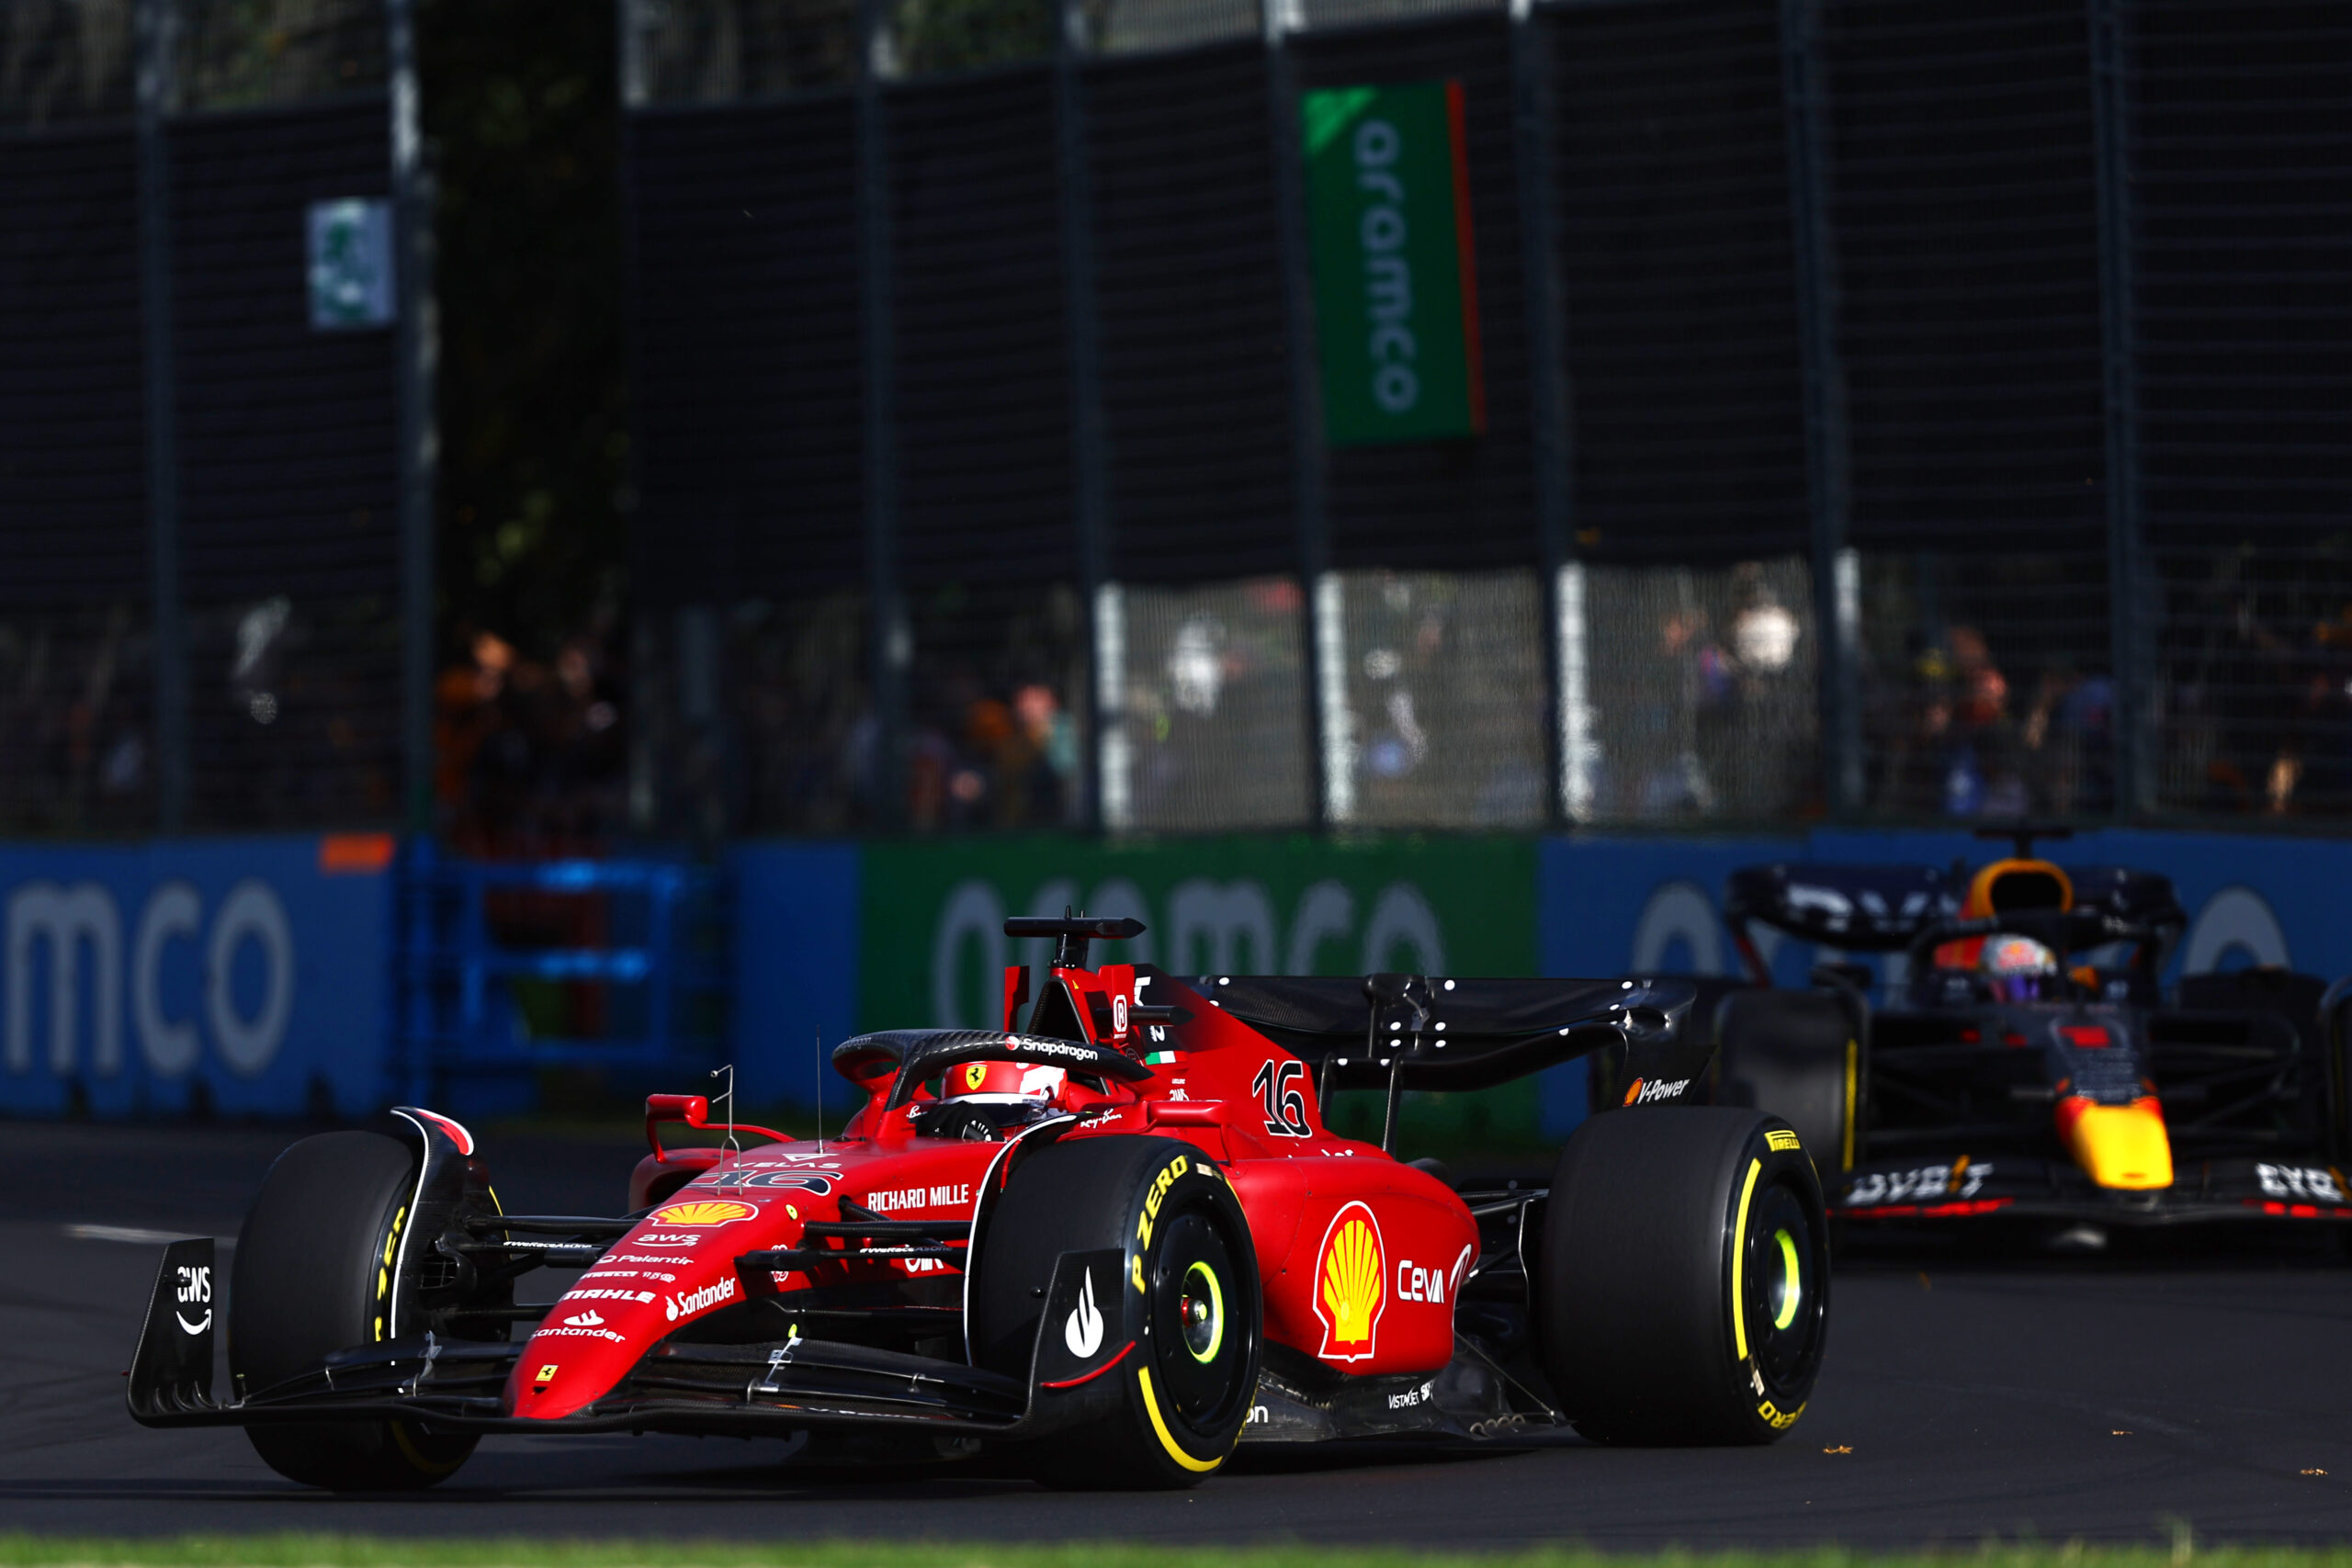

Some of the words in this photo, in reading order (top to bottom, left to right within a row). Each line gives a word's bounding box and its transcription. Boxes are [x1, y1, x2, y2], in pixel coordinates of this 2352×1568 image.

[1353, 118, 1419, 412] aramco
[5, 875, 295, 1077] mco
[1023, 1037, 1098, 1061] Snapdragon
[1252, 1058, 1313, 1138] 16
[1637, 1078, 1690, 1104] V-Power
[684, 1169, 844, 1197] 16
[867, 1188, 926, 1212] RICHARD
[930, 1183, 970, 1206] MILLE
[1136, 1155, 1188, 1251] ZERO
[638, 1233, 701, 1243] aws
[617, 1255, 694, 1265] Palantir
[1131, 1254, 1147, 1295] P
[176, 1266, 211, 1303] aws
[678, 1276, 735, 1316] Santander
